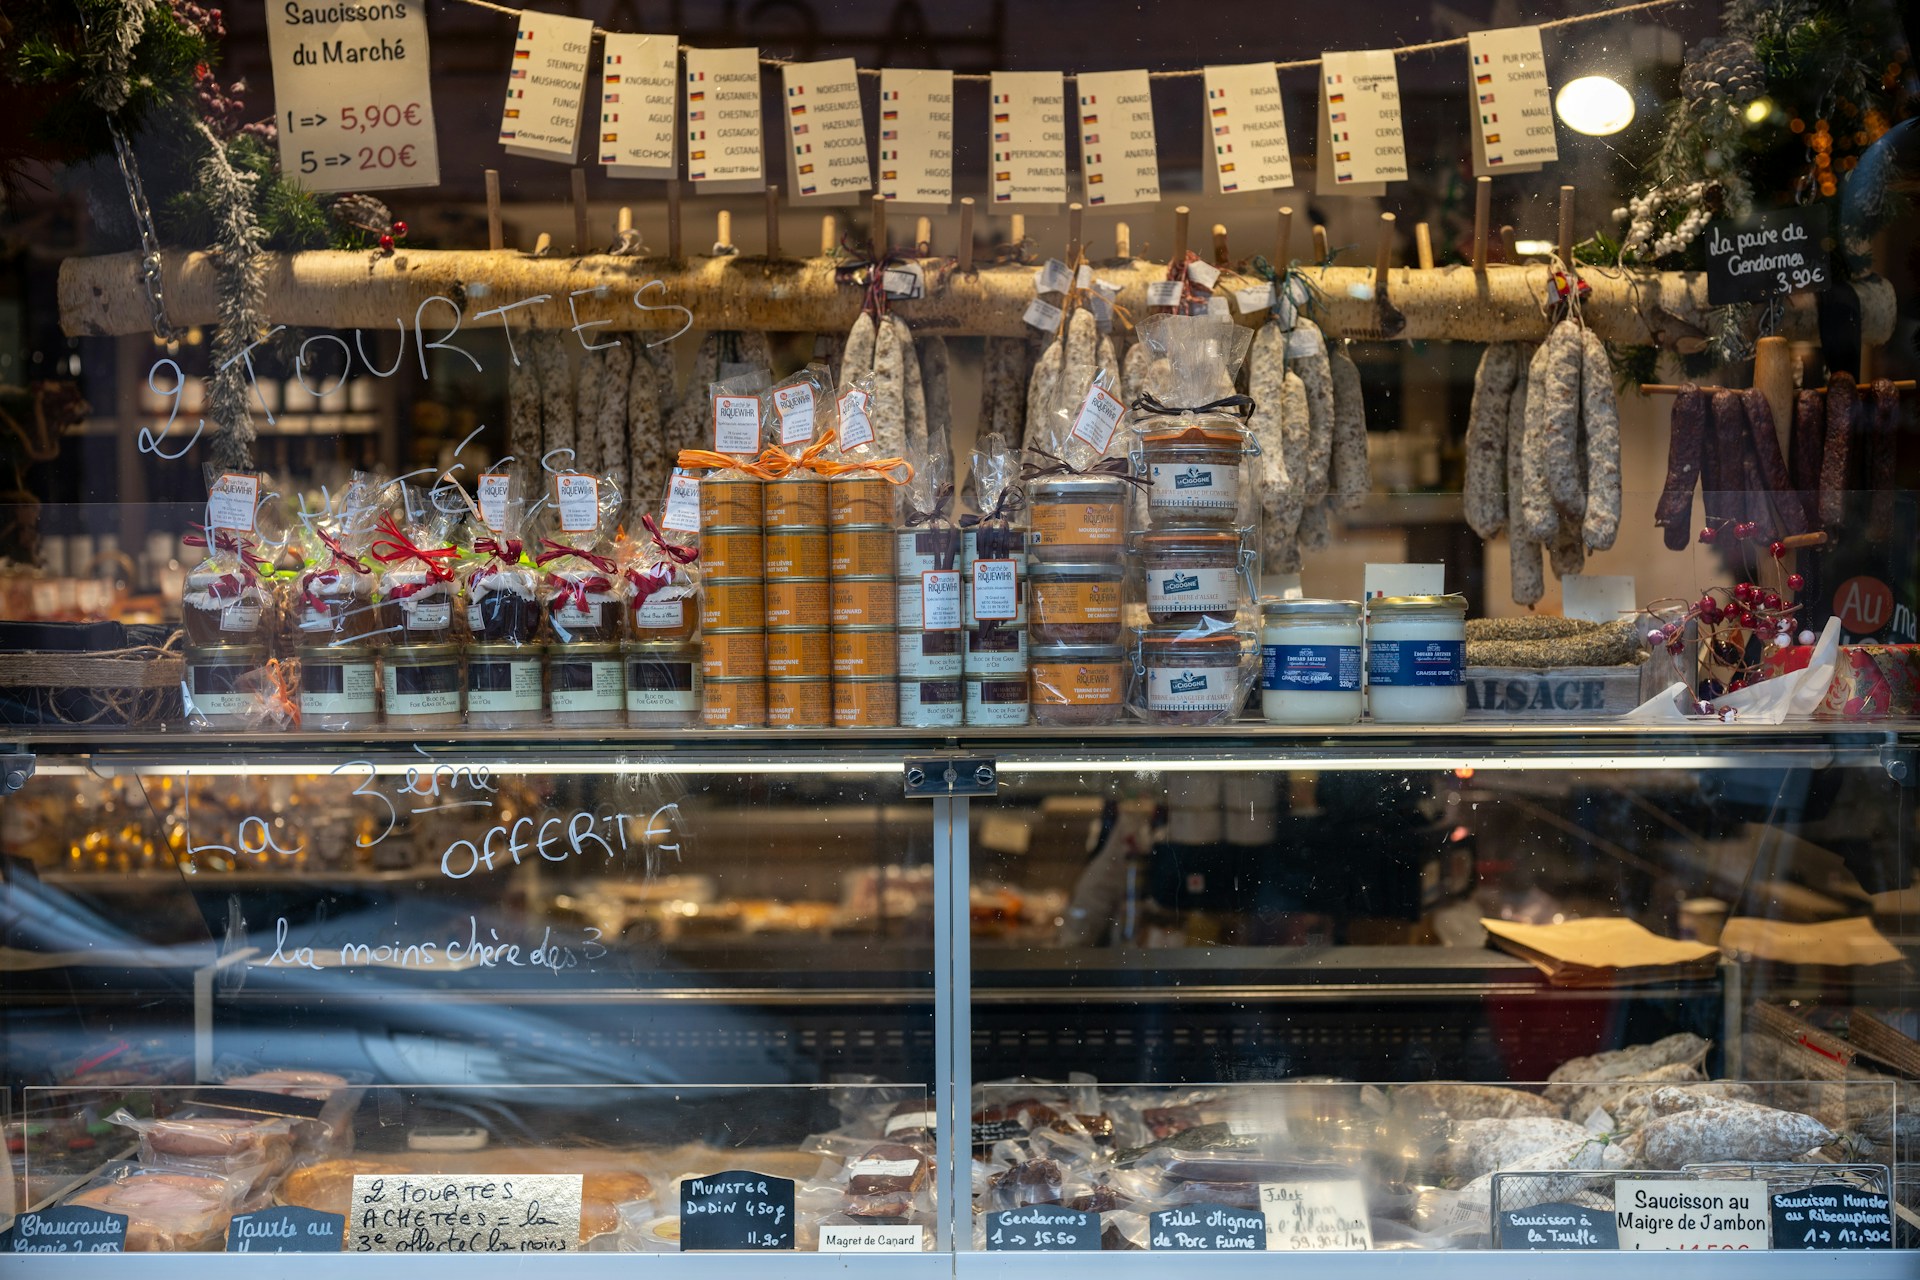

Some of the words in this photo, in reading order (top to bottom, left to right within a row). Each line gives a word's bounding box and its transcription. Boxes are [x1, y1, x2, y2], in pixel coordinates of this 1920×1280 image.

[285, 1, 407, 25] Saucissons
[293, 43, 317, 65] du
[322, 38, 406, 64] Marché
[1503, 53, 1519, 63] PUR
[1521, 51, 1543, 62] PORC
[547, 59, 584, 72] STEINPILZ
[1508, 70, 1545, 82] SCHWEIN
[531, 75, 581, 90] MUSHROOM
[625, 78, 674, 87] KNOBLAUCH
[816, 83, 857, 94] NOISETTES
[1250, 87, 1278, 96] FAISAN
[1534, 88, 1548, 97] PIG
[645, 95, 673, 105] GARLIC
[715, 92, 758, 100] KASTANIEN
[928, 94, 952, 102] FIGUE
[1032, 97, 1064, 105] PIMENT
[1117, 95, 1150, 104] CANARD
[1381, 92, 1398, 100] REH
[552, 98, 577, 109] FUNGI
[814, 102, 860, 112] HASELNUSS
[1255, 104, 1280, 113] FASAN
[719, 110, 759, 119] CHESTNUT
[929, 112, 951, 120] FEIGE
[1132, 113, 1151, 121] ENTE
[1379, 110, 1400, 119] DEER
[1522, 107, 1551, 118] MAIALE
[287, 111, 293, 133] 1
[341, 103, 422, 134] 5,90€
[648, 115, 672, 123] AGLIO
[1042, 114, 1063, 123] CHILI
[822, 120, 862, 130] HAZELNUT
[1243, 120, 1283, 132] PHEASANT
[717, 129, 760, 138] CASTAGNO
[938, 132, 951, 140] FIG
[1042, 132, 1063, 141] CHILI
[1131, 131, 1153, 140] DUCK
[1375, 128, 1402, 137] CERVO
[1526, 127, 1553, 136] CERDO
[656, 134, 671, 142] AJO
[824, 138, 865, 148] NOCCIOLA
[1251, 137, 1285, 148] FAGIANO
[629, 149, 670, 159] ЧЕСНОК
[1011, 150, 1064, 158] PEPERONCINO
[1125, 149, 1155, 158] ANATRA
[1375, 146, 1403, 156] CIERVO
[301, 151, 318, 174] 5
[358, 144, 417, 170] 20€
[828, 156, 868, 167] AVELLANA
[1263, 155, 1288, 165] FASAN
[925, 169, 951, 177] HIGOS
[1027, 168, 1065, 176] PIMIENTA
[1137, 168, 1156, 176] PATO
[1375, 167, 1406, 175] олень
[1258, 173, 1291, 184] фазан
[917, 188, 950, 197] инжир
[1135, 188, 1158, 197] утка
[1737, 229, 1778, 254] paire
[1782, 223, 1808, 242] de
[1728, 253, 1804, 276] Gendarmes
[1777, 268, 1825, 294] 3,90€
[138, 358, 205, 460] 2
[220, 279, 694, 425] TOURTES
[780, 394, 810, 409] RIQUEWIHR
[720, 408, 754, 419] RIQUEWIHR
[561, 487, 594, 497] RIQUEWIHR
[978, 572, 1012, 583] RIQUEWIHR
[1840, 582, 1883, 625] Au
[185, 770, 304, 856] La
[340, 940, 435, 968] moins
[445, 915, 526, 971] chère
[530, 926, 579, 976] des
[364, 1178, 386, 1204] 2
[397, 1181, 513, 1203] TOURTES
[692, 1181, 769, 1196] MUNSTER
[1263, 1188, 1303, 1202] Filet
[1635, 1190, 1723, 1209] Saucisson
[1729, 1197, 1749, 1209] au
[1774, 1194, 1837, 1208] Saucisson
[1843, 1194, 1888, 1209] Munster
[519, 1200, 559, 1228] la
[999, 1209, 1087, 1226] Gendarmes
[1785, 1212, 1804, 1221] au
[1158, 1209, 1201, 1227] Filet
[1206, 1210, 1263, 1234] Mignon
[1510, 1214, 1576, 1226] Saucisson
[1580, 1214, 1592, 1226] à
[1618, 1212, 1673, 1234] Maigre
[1678, 1213, 1696, 1230] de
[1700, 1213, 1765, 1231] Jambon
[232, 1216, 297, 1238] Tourte
[307, 1222, 333, 1235] au
[826, 1235, 862, 1246] Magret
[864, 1235, 875, 1245] de
[878, 1235, 915, 1246] Canard
[991, 1229, 1003, 1245] 1
[1034, 1230, 1077, 1247] 15.50
[1153, 1233, 1172, 1247] de
[1178, 1233, 1208, 1249] Porc
[1528, 1229, 1546, 1243] la
[1547, 1229, 1598, 1245] Truffe
[1804, 1229, 1816, 1243] 1
[1838, 1229, 1890, 1243] 12,90€
[520, 1237, 567, 1251] moins
